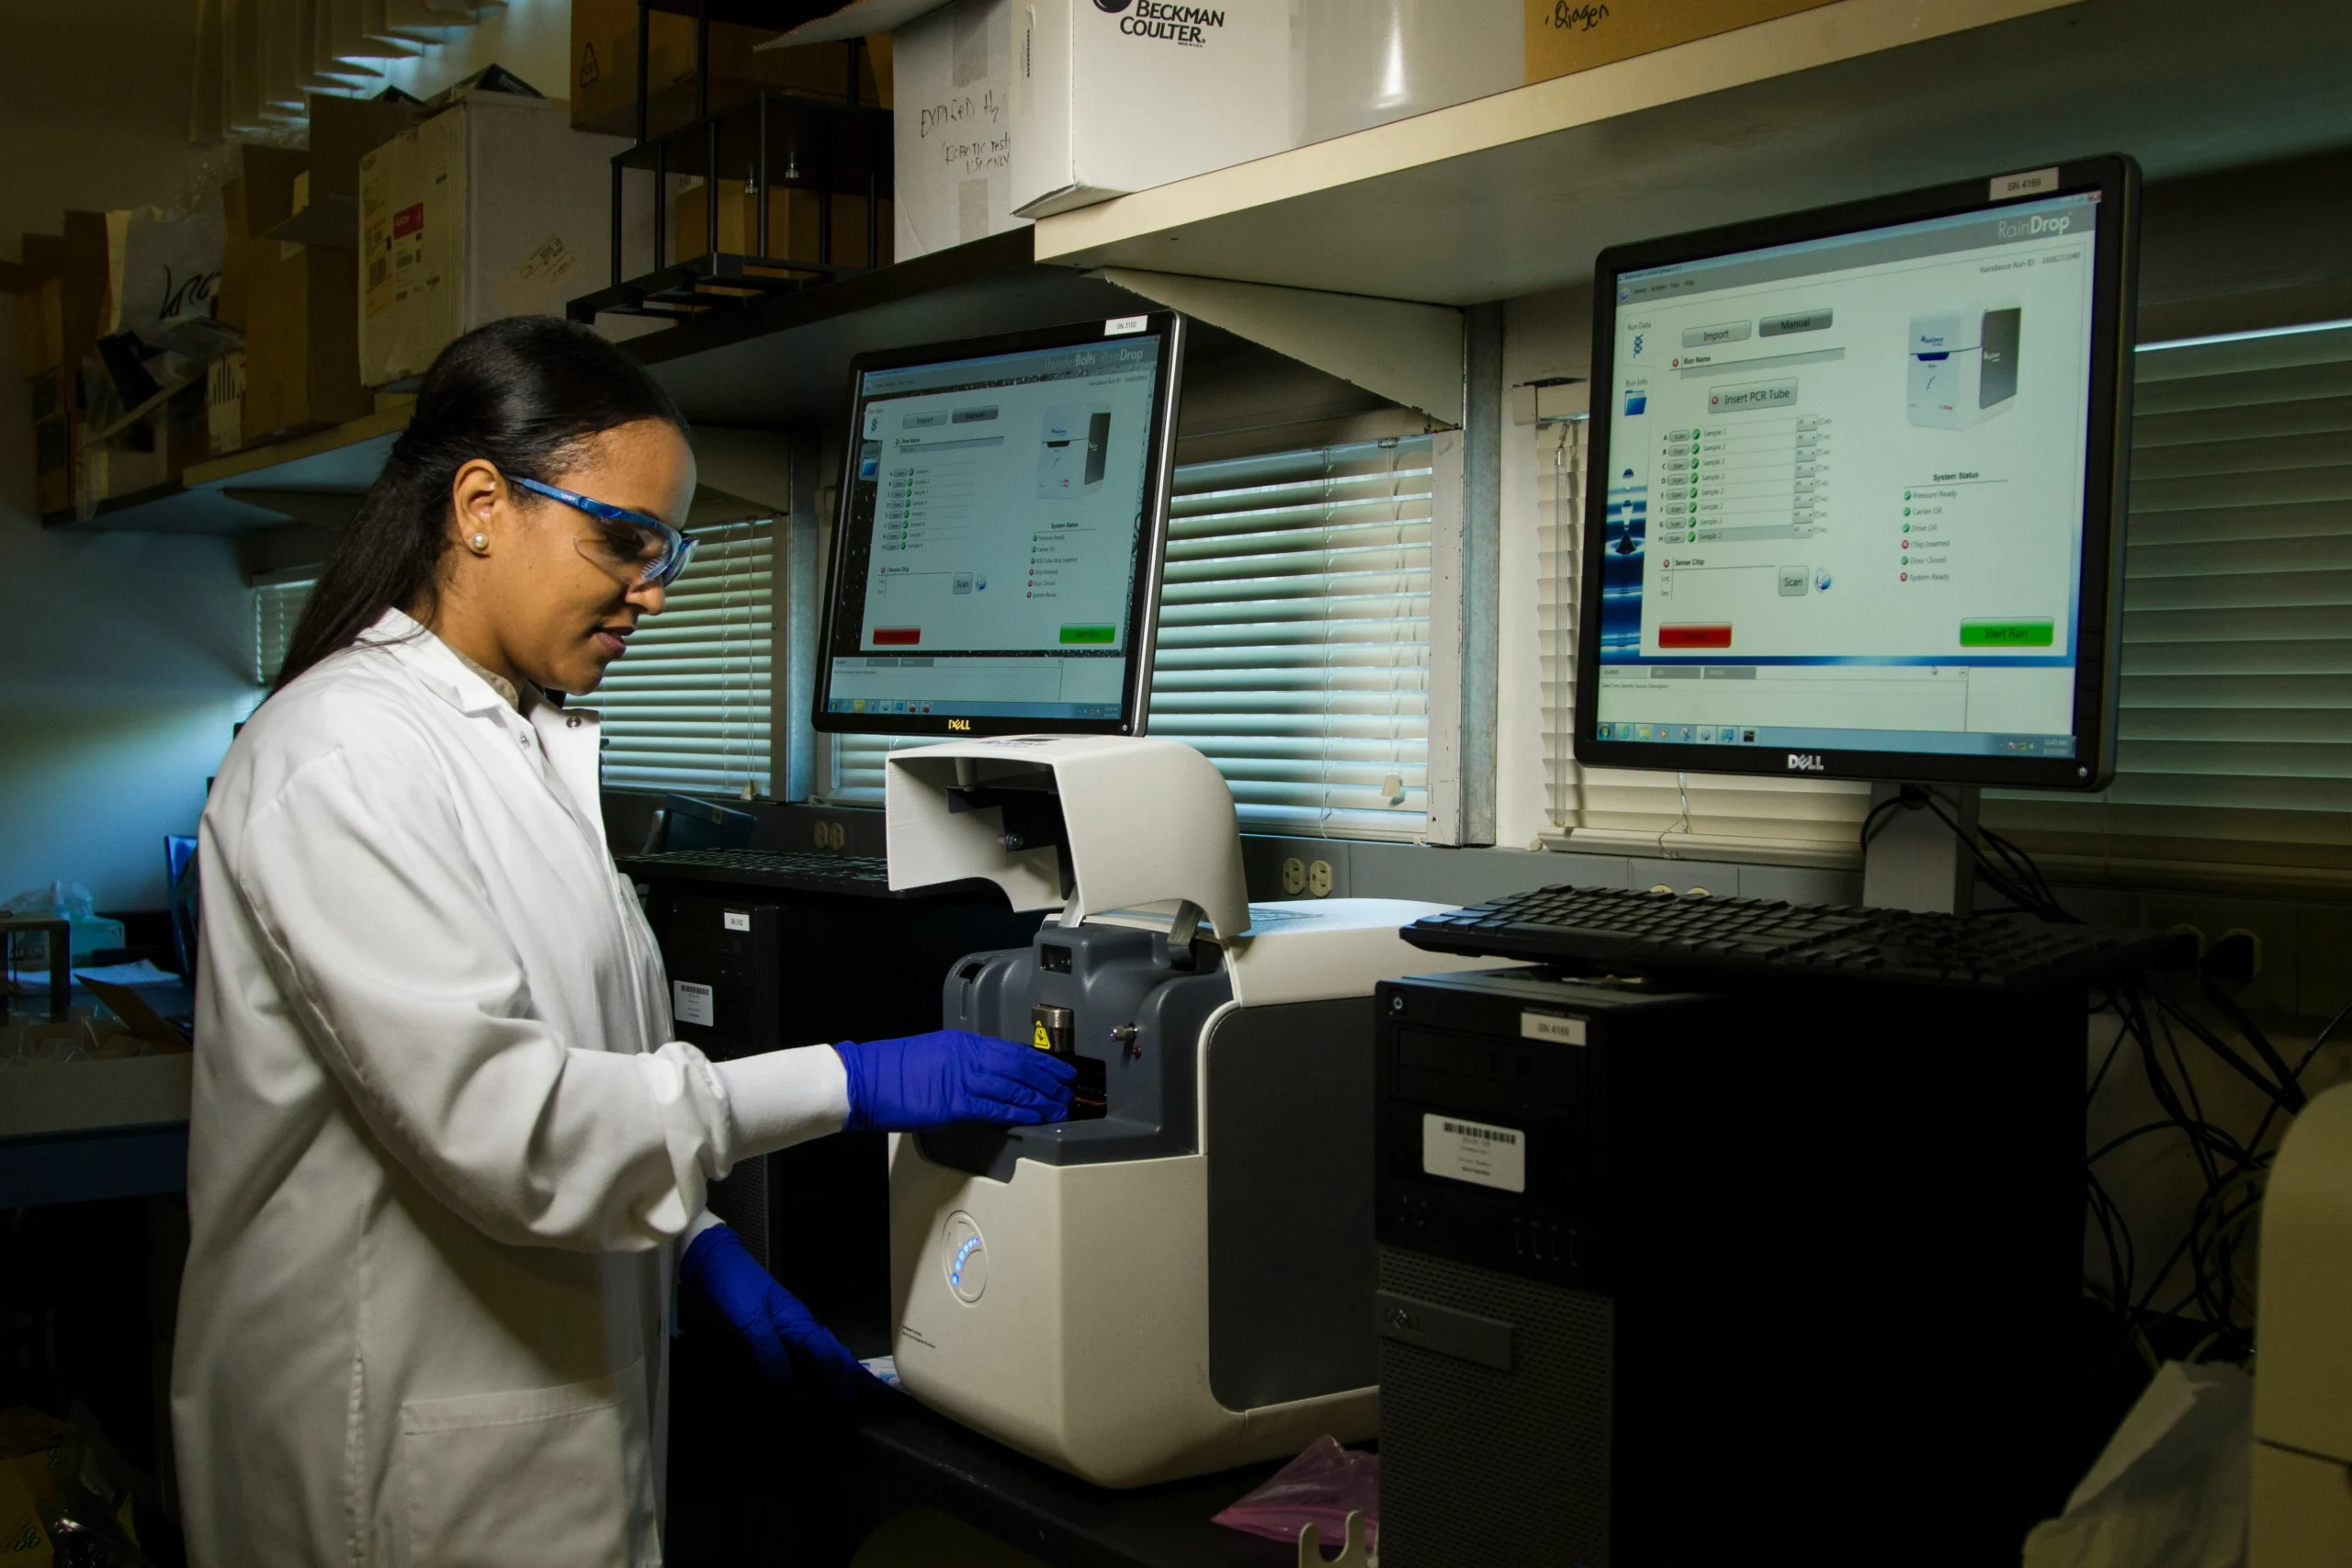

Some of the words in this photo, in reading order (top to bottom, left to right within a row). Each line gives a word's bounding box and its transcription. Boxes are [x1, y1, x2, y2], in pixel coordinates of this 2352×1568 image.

[1136, 0, 1225, 28] BECKMAN
[1998, 215, 2070, 240] RainDrop
[1781, 319, 1810, 330] Manual
[1703, 331, 1729, 342] Import
[1724, 391, 1747, 404] Insert
[1749, 389, 1767, 401] PCR
[1769, 389, 1790, 400] Tube
[1933, 474, 1957, 482] System
[1959, 471, 1979, 479] Status
[1939, 490, 1957, 498] Ready
[1911, 540, 1924, 548] Chip
[1692, 558, 1704, 567] Chip
[1784, 577, 1803, 587] Scan
[1909, 574, 1930, 582] System
[1931, 573, 1950, 581] Ready
[1984, 627, 2006, 638] Start
[2009, 627, 2027, 638] Run
[948, 719, 970, 730] DELL
[1787, 753, 1824, 771] DELL
